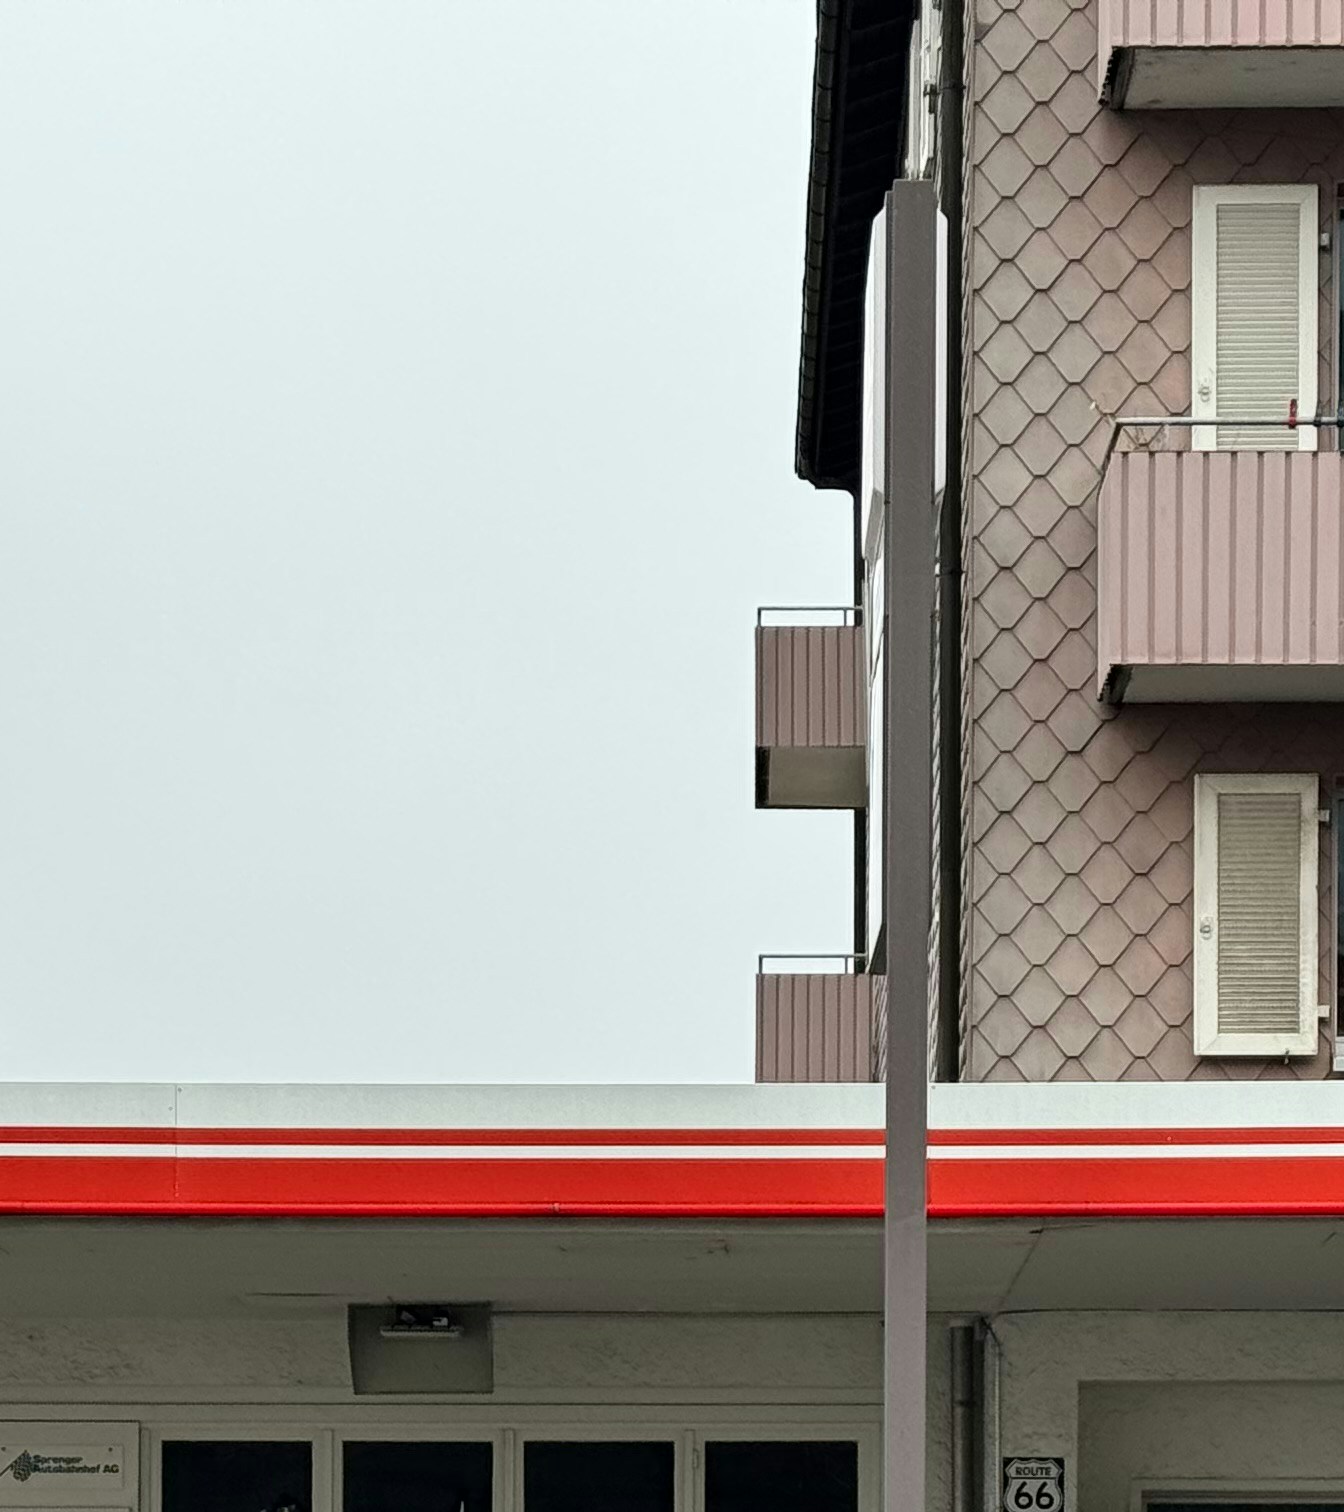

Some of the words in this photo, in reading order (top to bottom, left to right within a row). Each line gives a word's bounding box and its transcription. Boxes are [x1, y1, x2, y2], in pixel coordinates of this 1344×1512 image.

[102, 1464, 120, 1474] AG
[1015, 1466, 1052, 1476] ROUTE
[1014, 1481, 1054, 1509] 66
